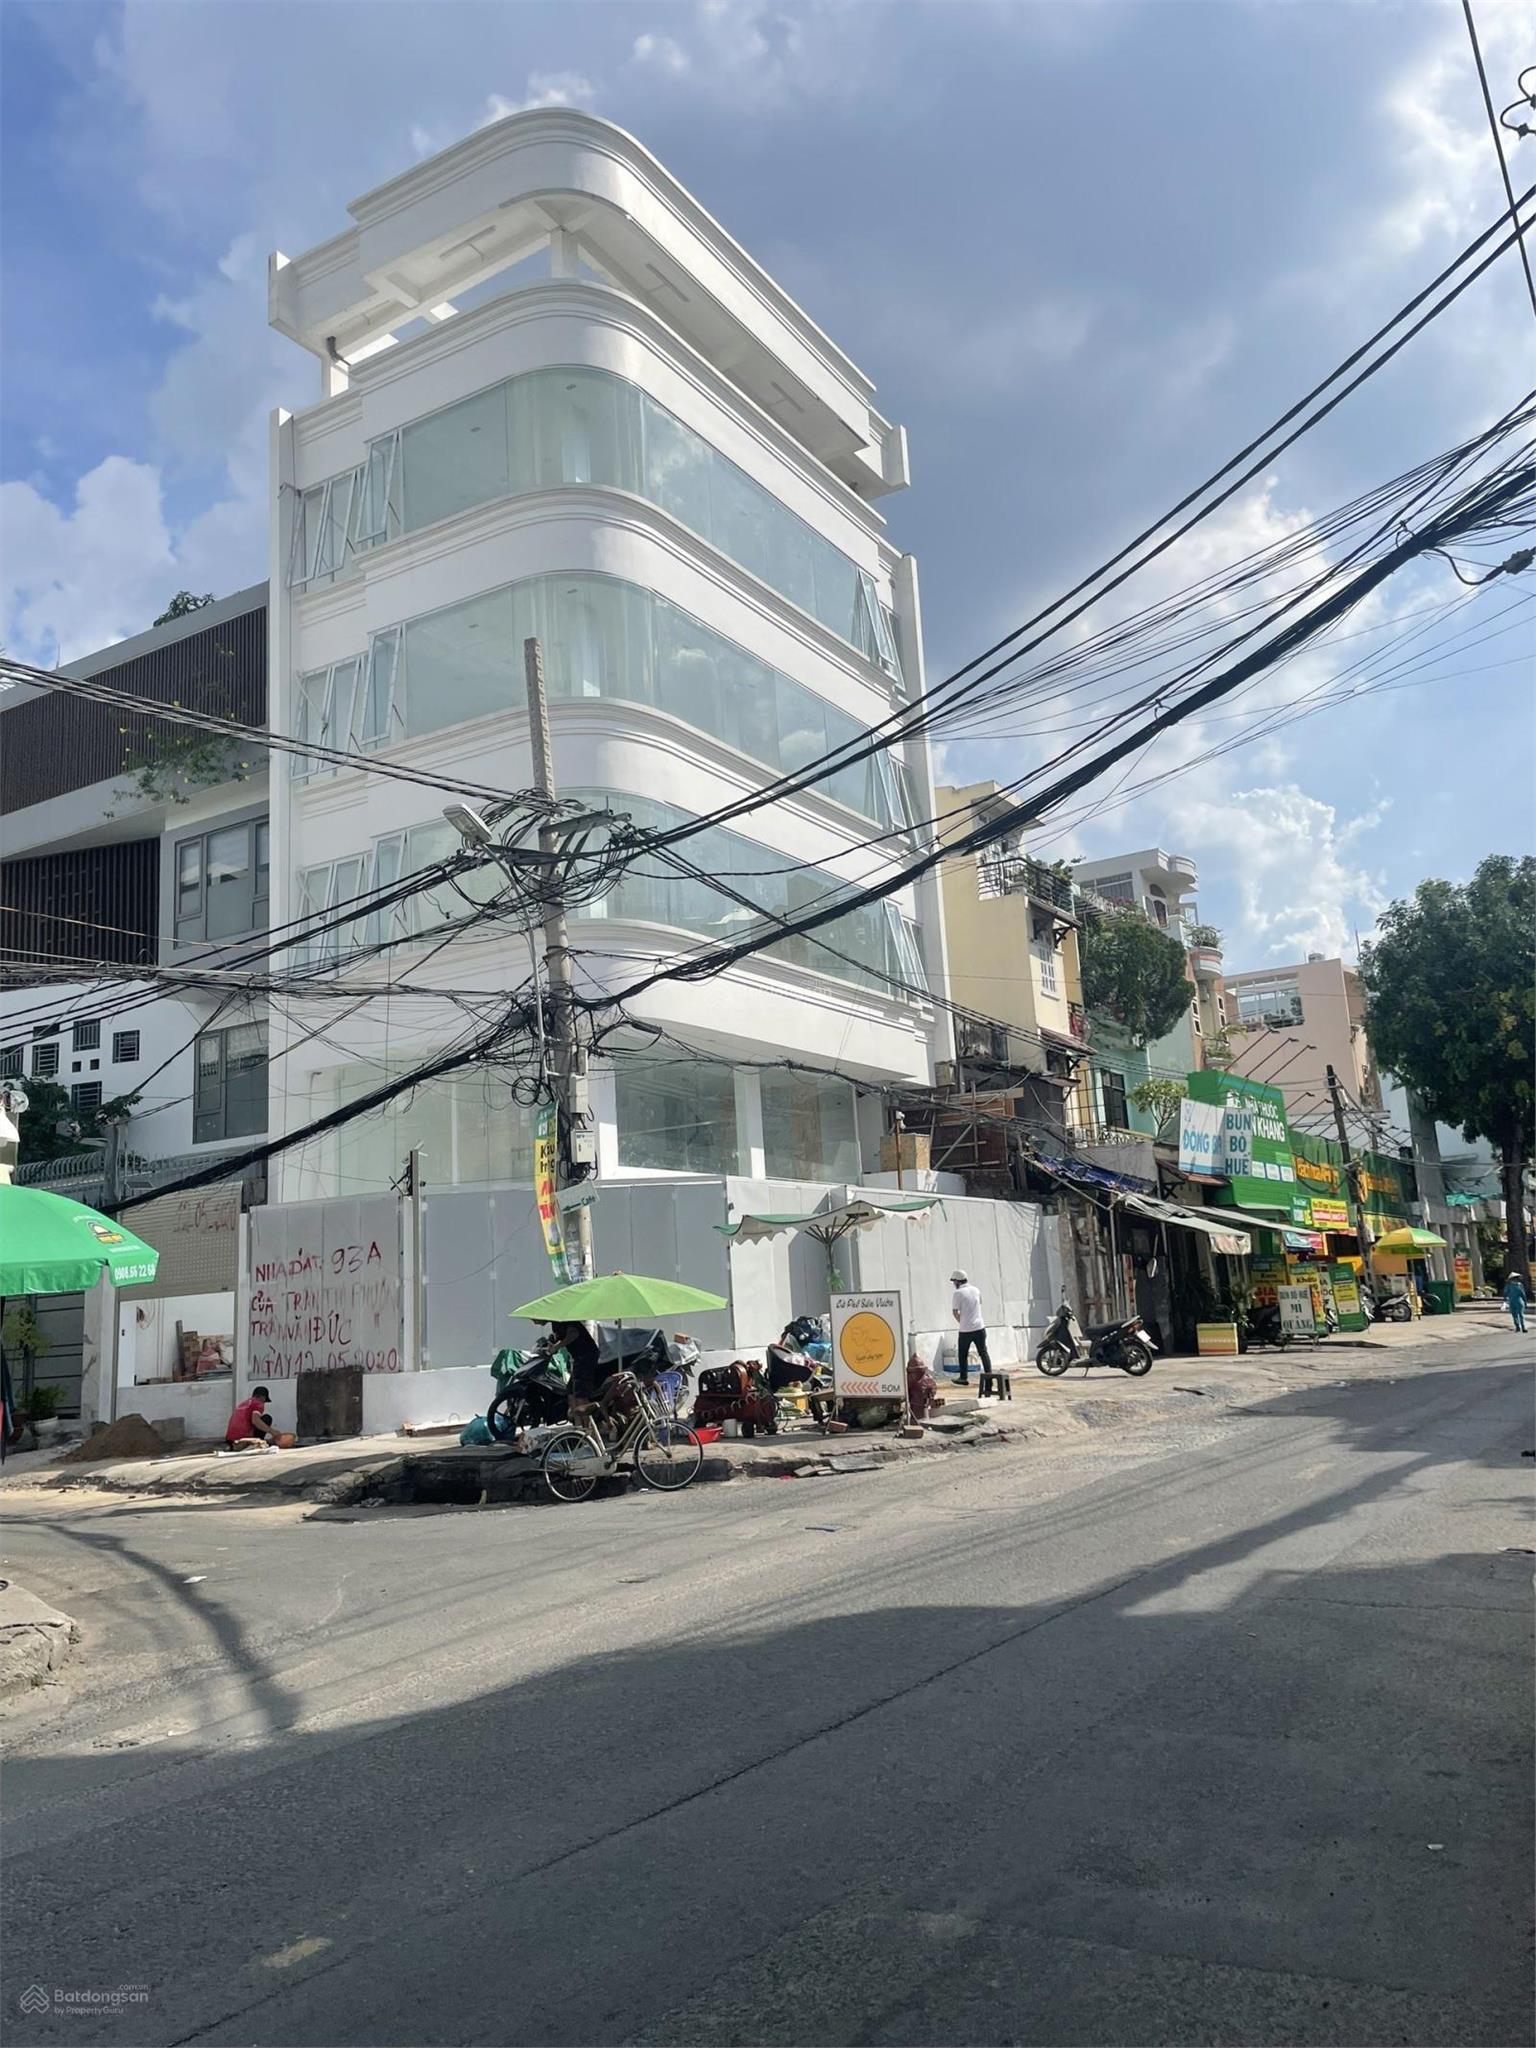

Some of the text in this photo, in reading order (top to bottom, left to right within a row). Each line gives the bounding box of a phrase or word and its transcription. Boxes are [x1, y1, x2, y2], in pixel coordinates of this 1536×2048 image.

[1257, 1117, 1286, 1142] KHANG
[1229, 1131, 1247, 1152] BÒ
[1224, 1152, 1250, 1175] HUẾ
[881, 1384, 901, 1393] 50M
